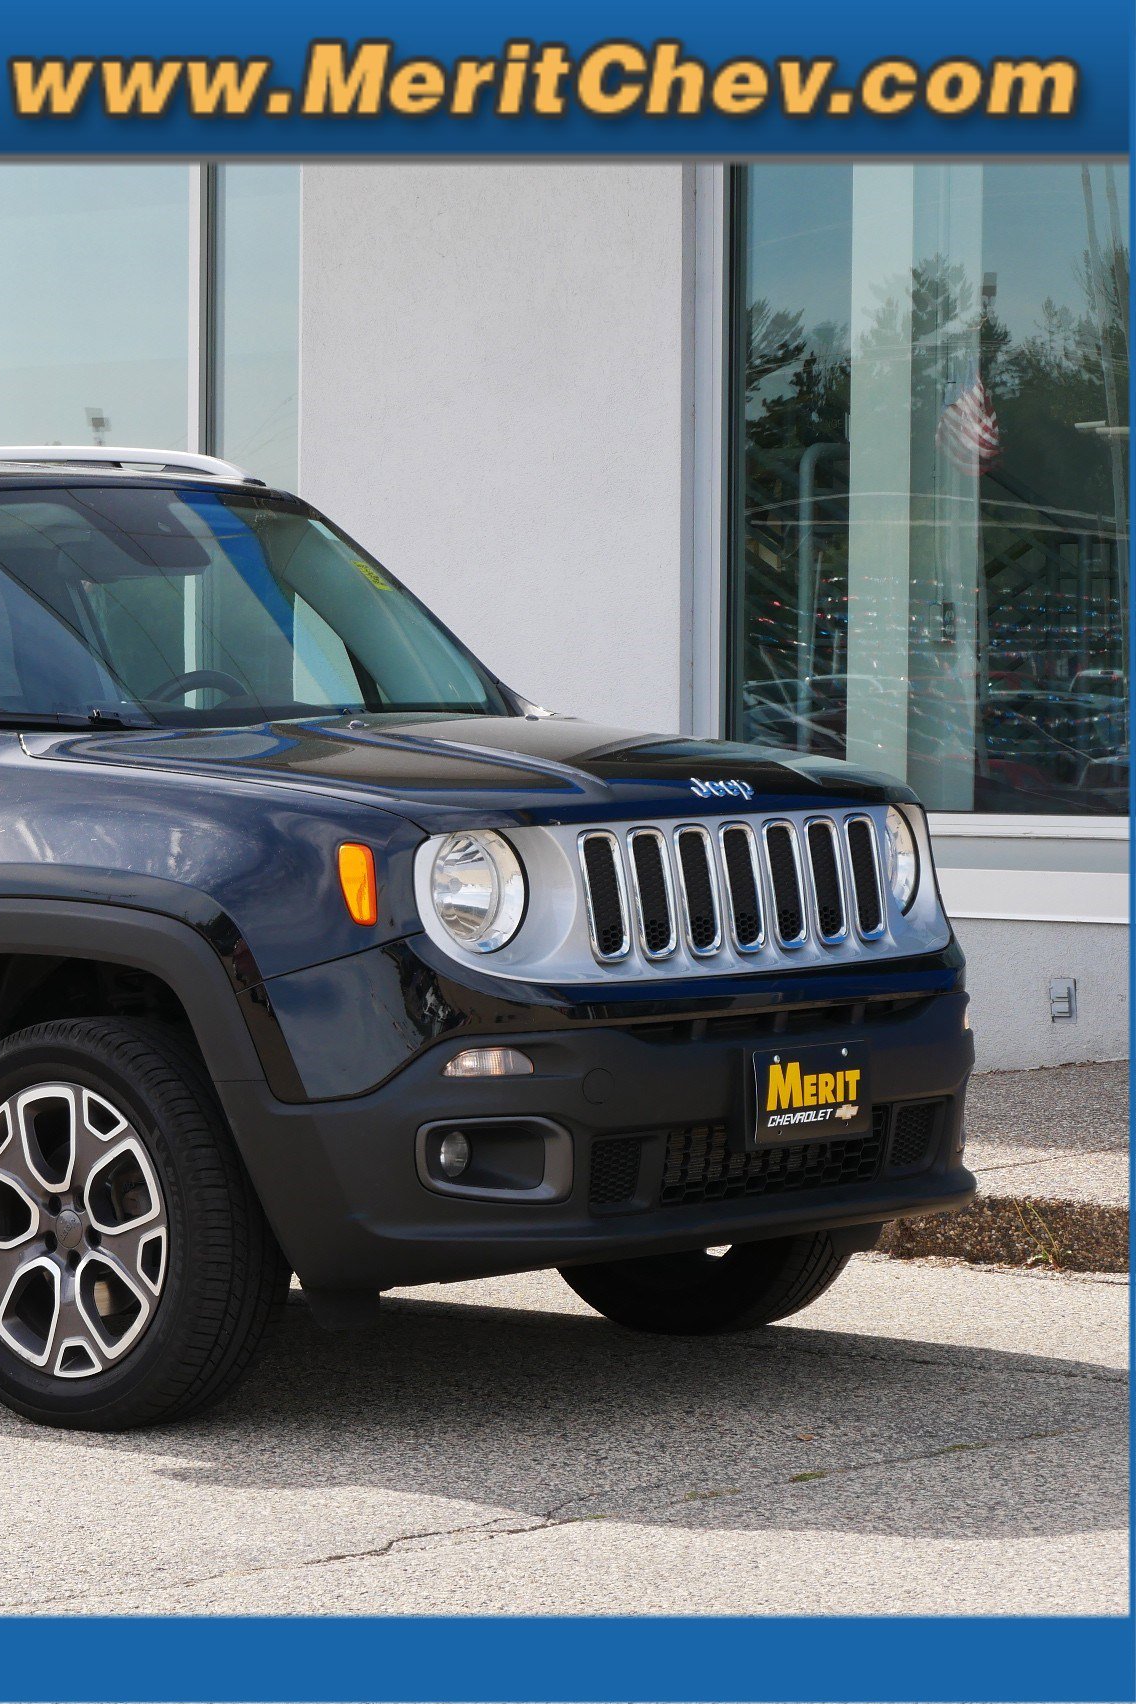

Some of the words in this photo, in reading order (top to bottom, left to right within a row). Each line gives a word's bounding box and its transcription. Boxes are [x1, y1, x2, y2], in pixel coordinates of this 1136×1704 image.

[690, 777, 755, 800] Jeep
[766, 1062, 860, 1111] MERIT
[768, 1108, 833, 1127] CHEVROLET
